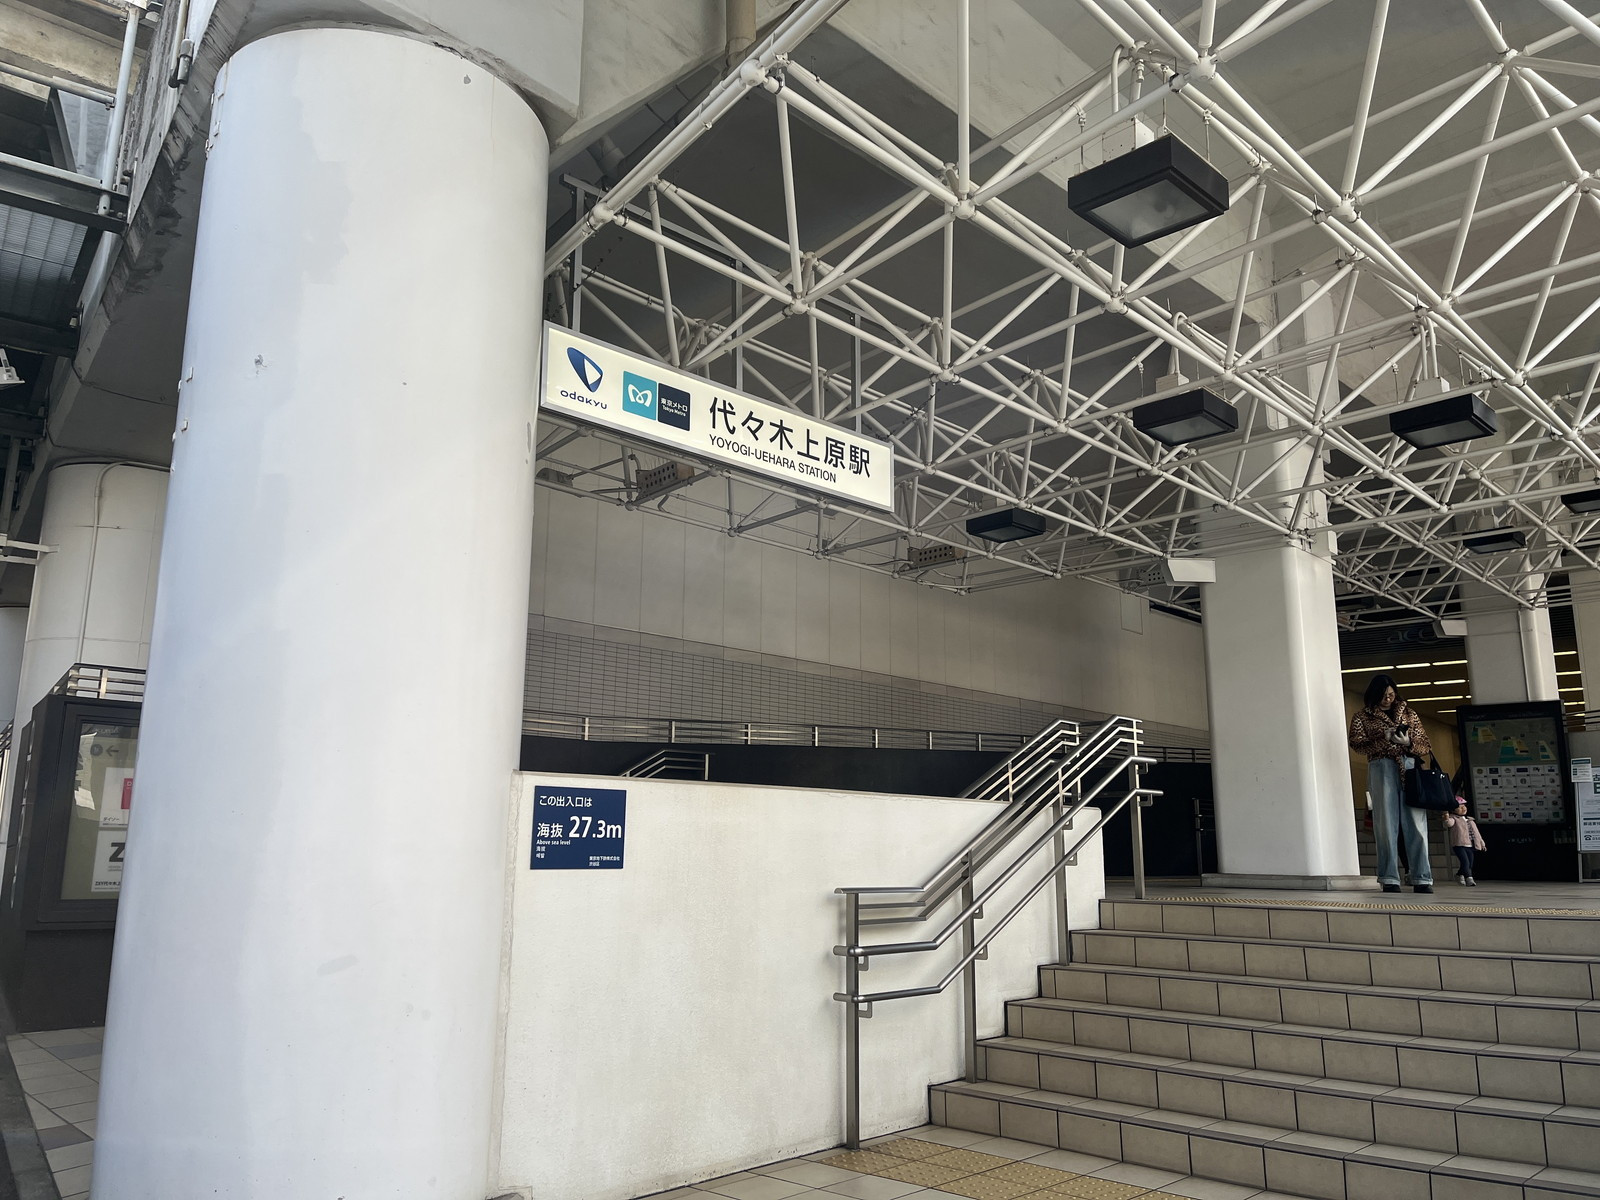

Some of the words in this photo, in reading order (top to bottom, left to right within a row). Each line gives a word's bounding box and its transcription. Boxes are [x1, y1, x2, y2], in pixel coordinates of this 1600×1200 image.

[660, 397, 688, 412] 東京メトロ
[662, 405, 674, 413] Tokyo
[709, 396, 871, 478] 代々木上原駅
[709, 434, 796, 471] YOYOGI-UEHARA
[798, 462, 837, 483] STATION
[539, 795, 593, 807] この出入口は
[537, 822, 563, 838] 海抜
[568, 816, 622, 838] 27.3m
